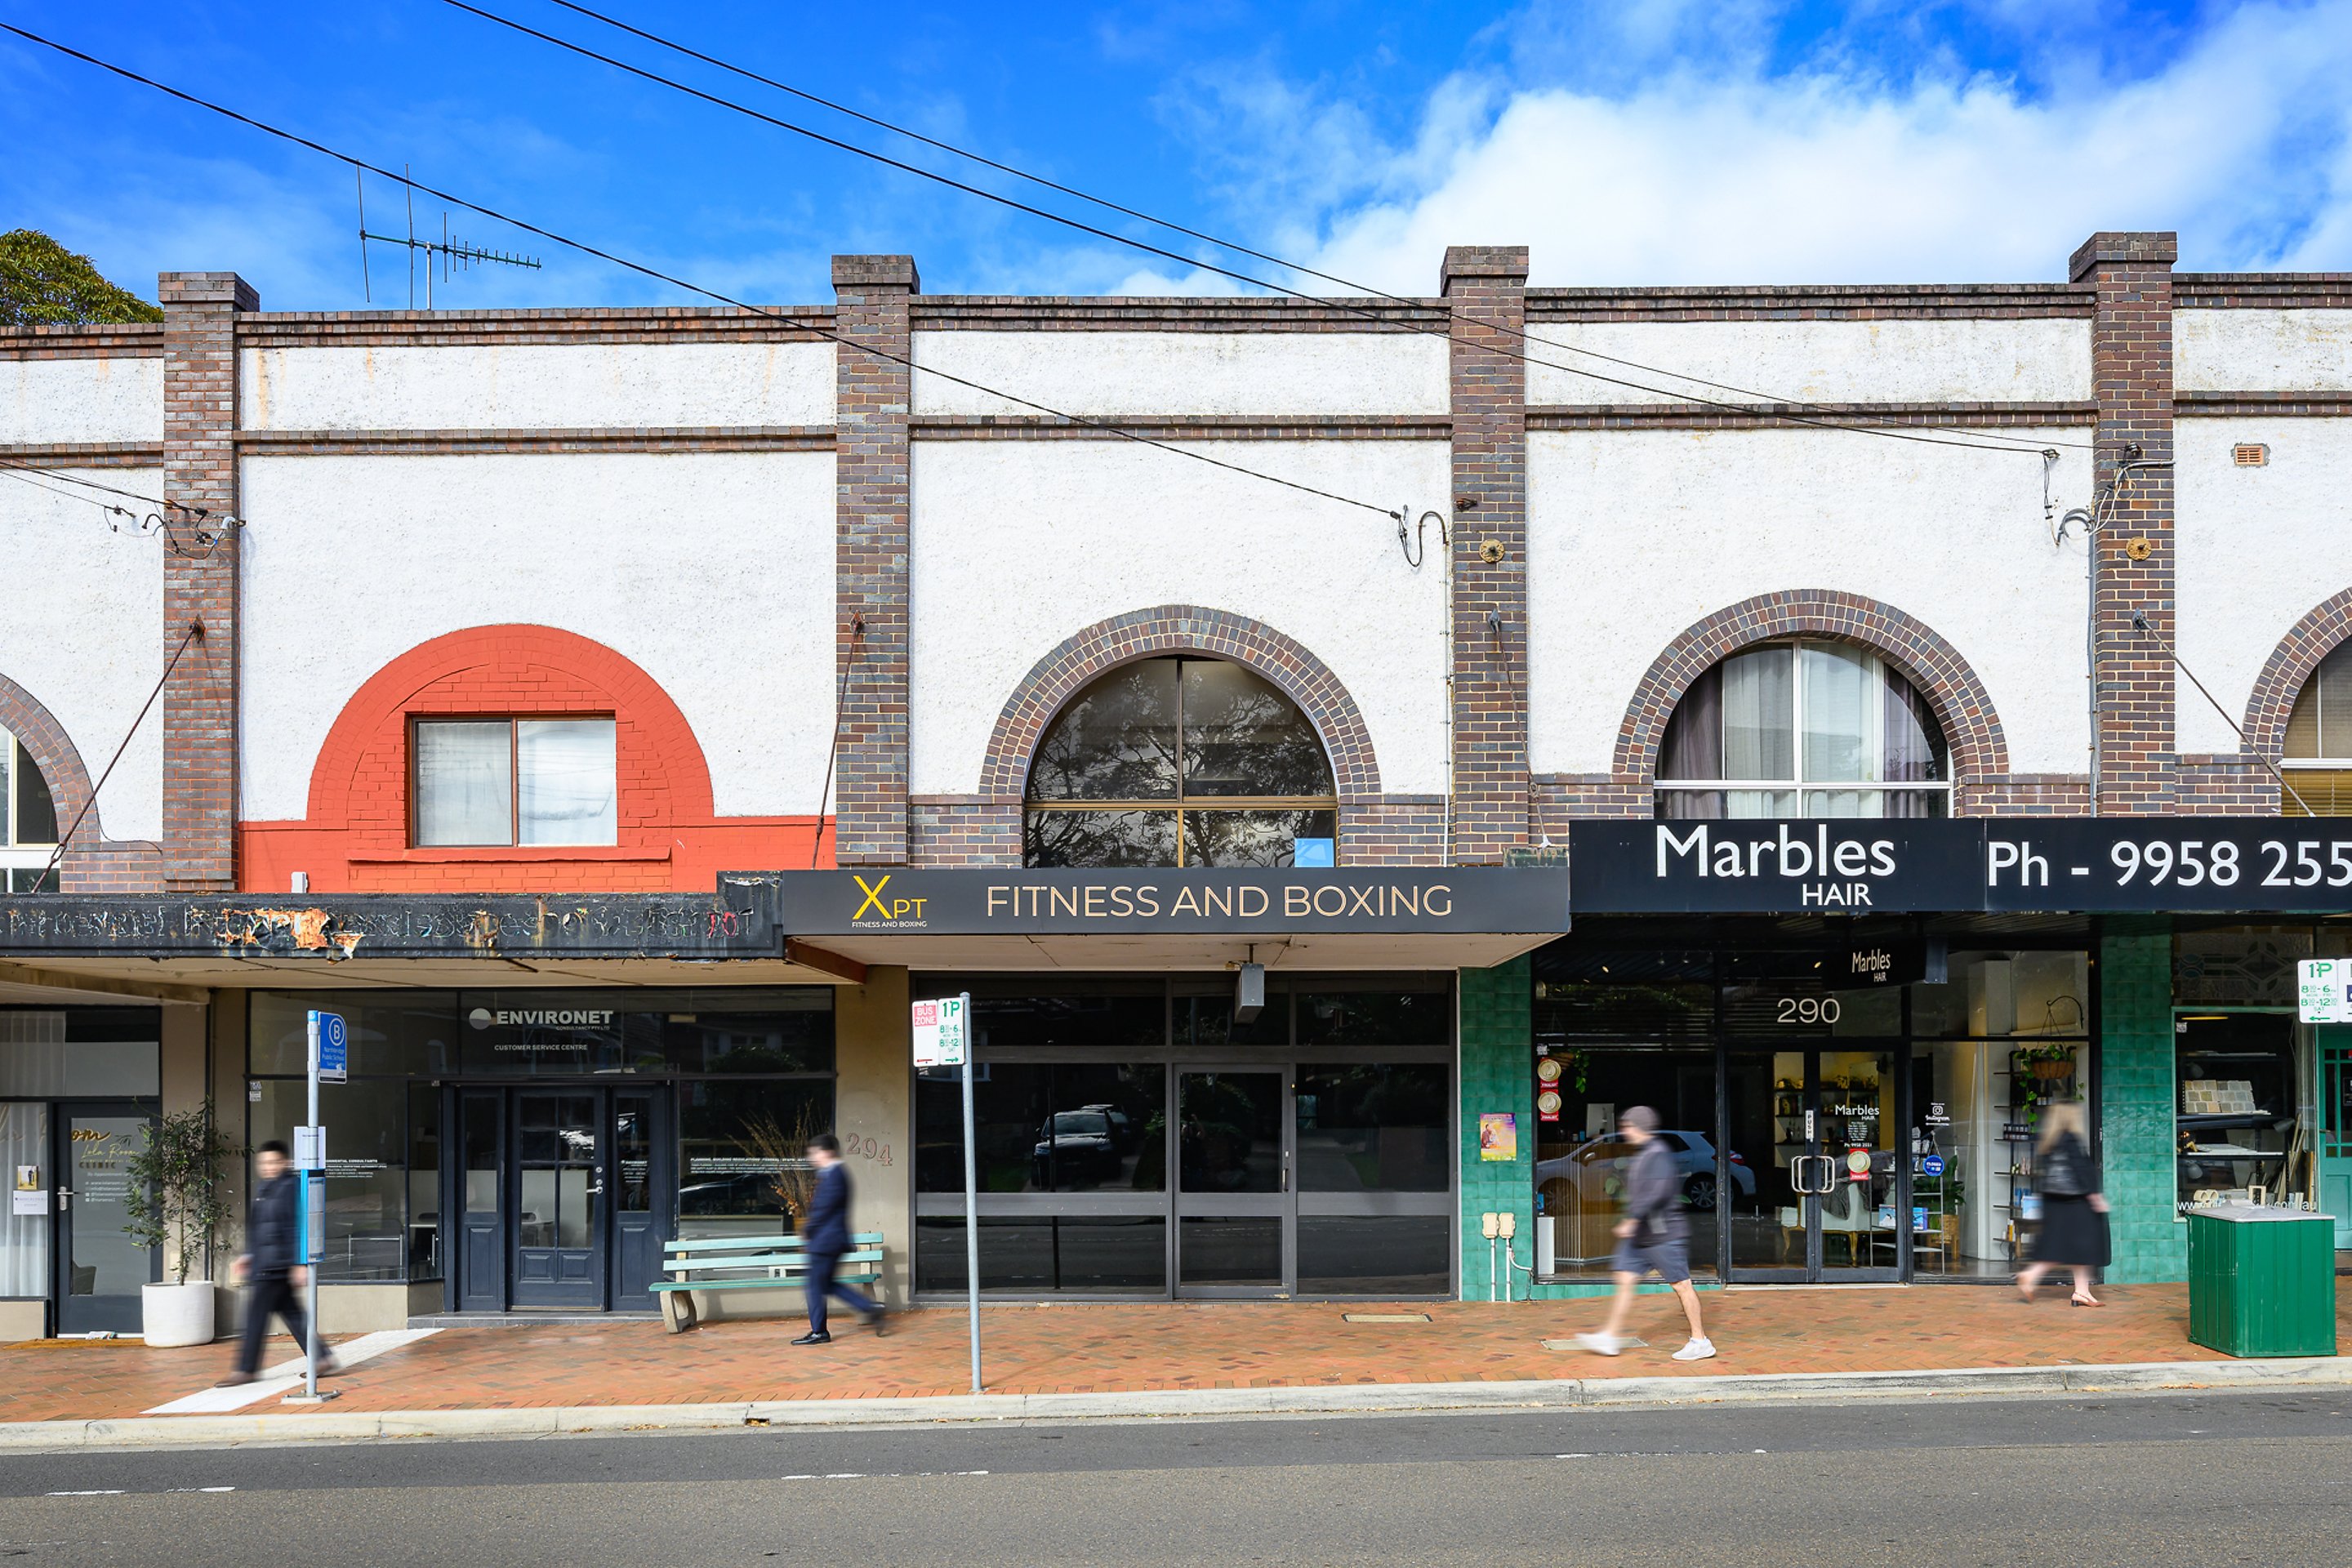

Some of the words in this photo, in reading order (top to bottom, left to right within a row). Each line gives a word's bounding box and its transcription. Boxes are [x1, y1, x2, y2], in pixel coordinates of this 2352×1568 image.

[1657, 824, 1895, 877] Marbles
[1988, 841, 2048, 886] Ph
[2070, 867, 2089, 875] -
[2111, 841, 2239, 886] 9958
[987, 886, 1160, 916] FITNESS
[1170, 886, 1269, 916] AND
[1284, 885, 1452, 916] BOXING
[1802, 884, 1873, 906] HAIR
[1851, 948, 1891, 973] Marbles
[1873, 972, 1886, 982] HAIR
[2309, 963, 2332, 978] 1P
[917, 1007, 933, 1016] BUS
[942, 1001, 960, 1017] 1P
[1777, 998, 1840, 1023] 290
[497, 1011, 613, 1024] ENVIRONET
[915, 1016, 935, 1025] ZONE
[334, 1024, 341, 1040] B
[1835, 1104, 1879, 1116] Marbles
[81, 1142, 105, 1159] Lola
[846, 1132, 893, 1166] 294
